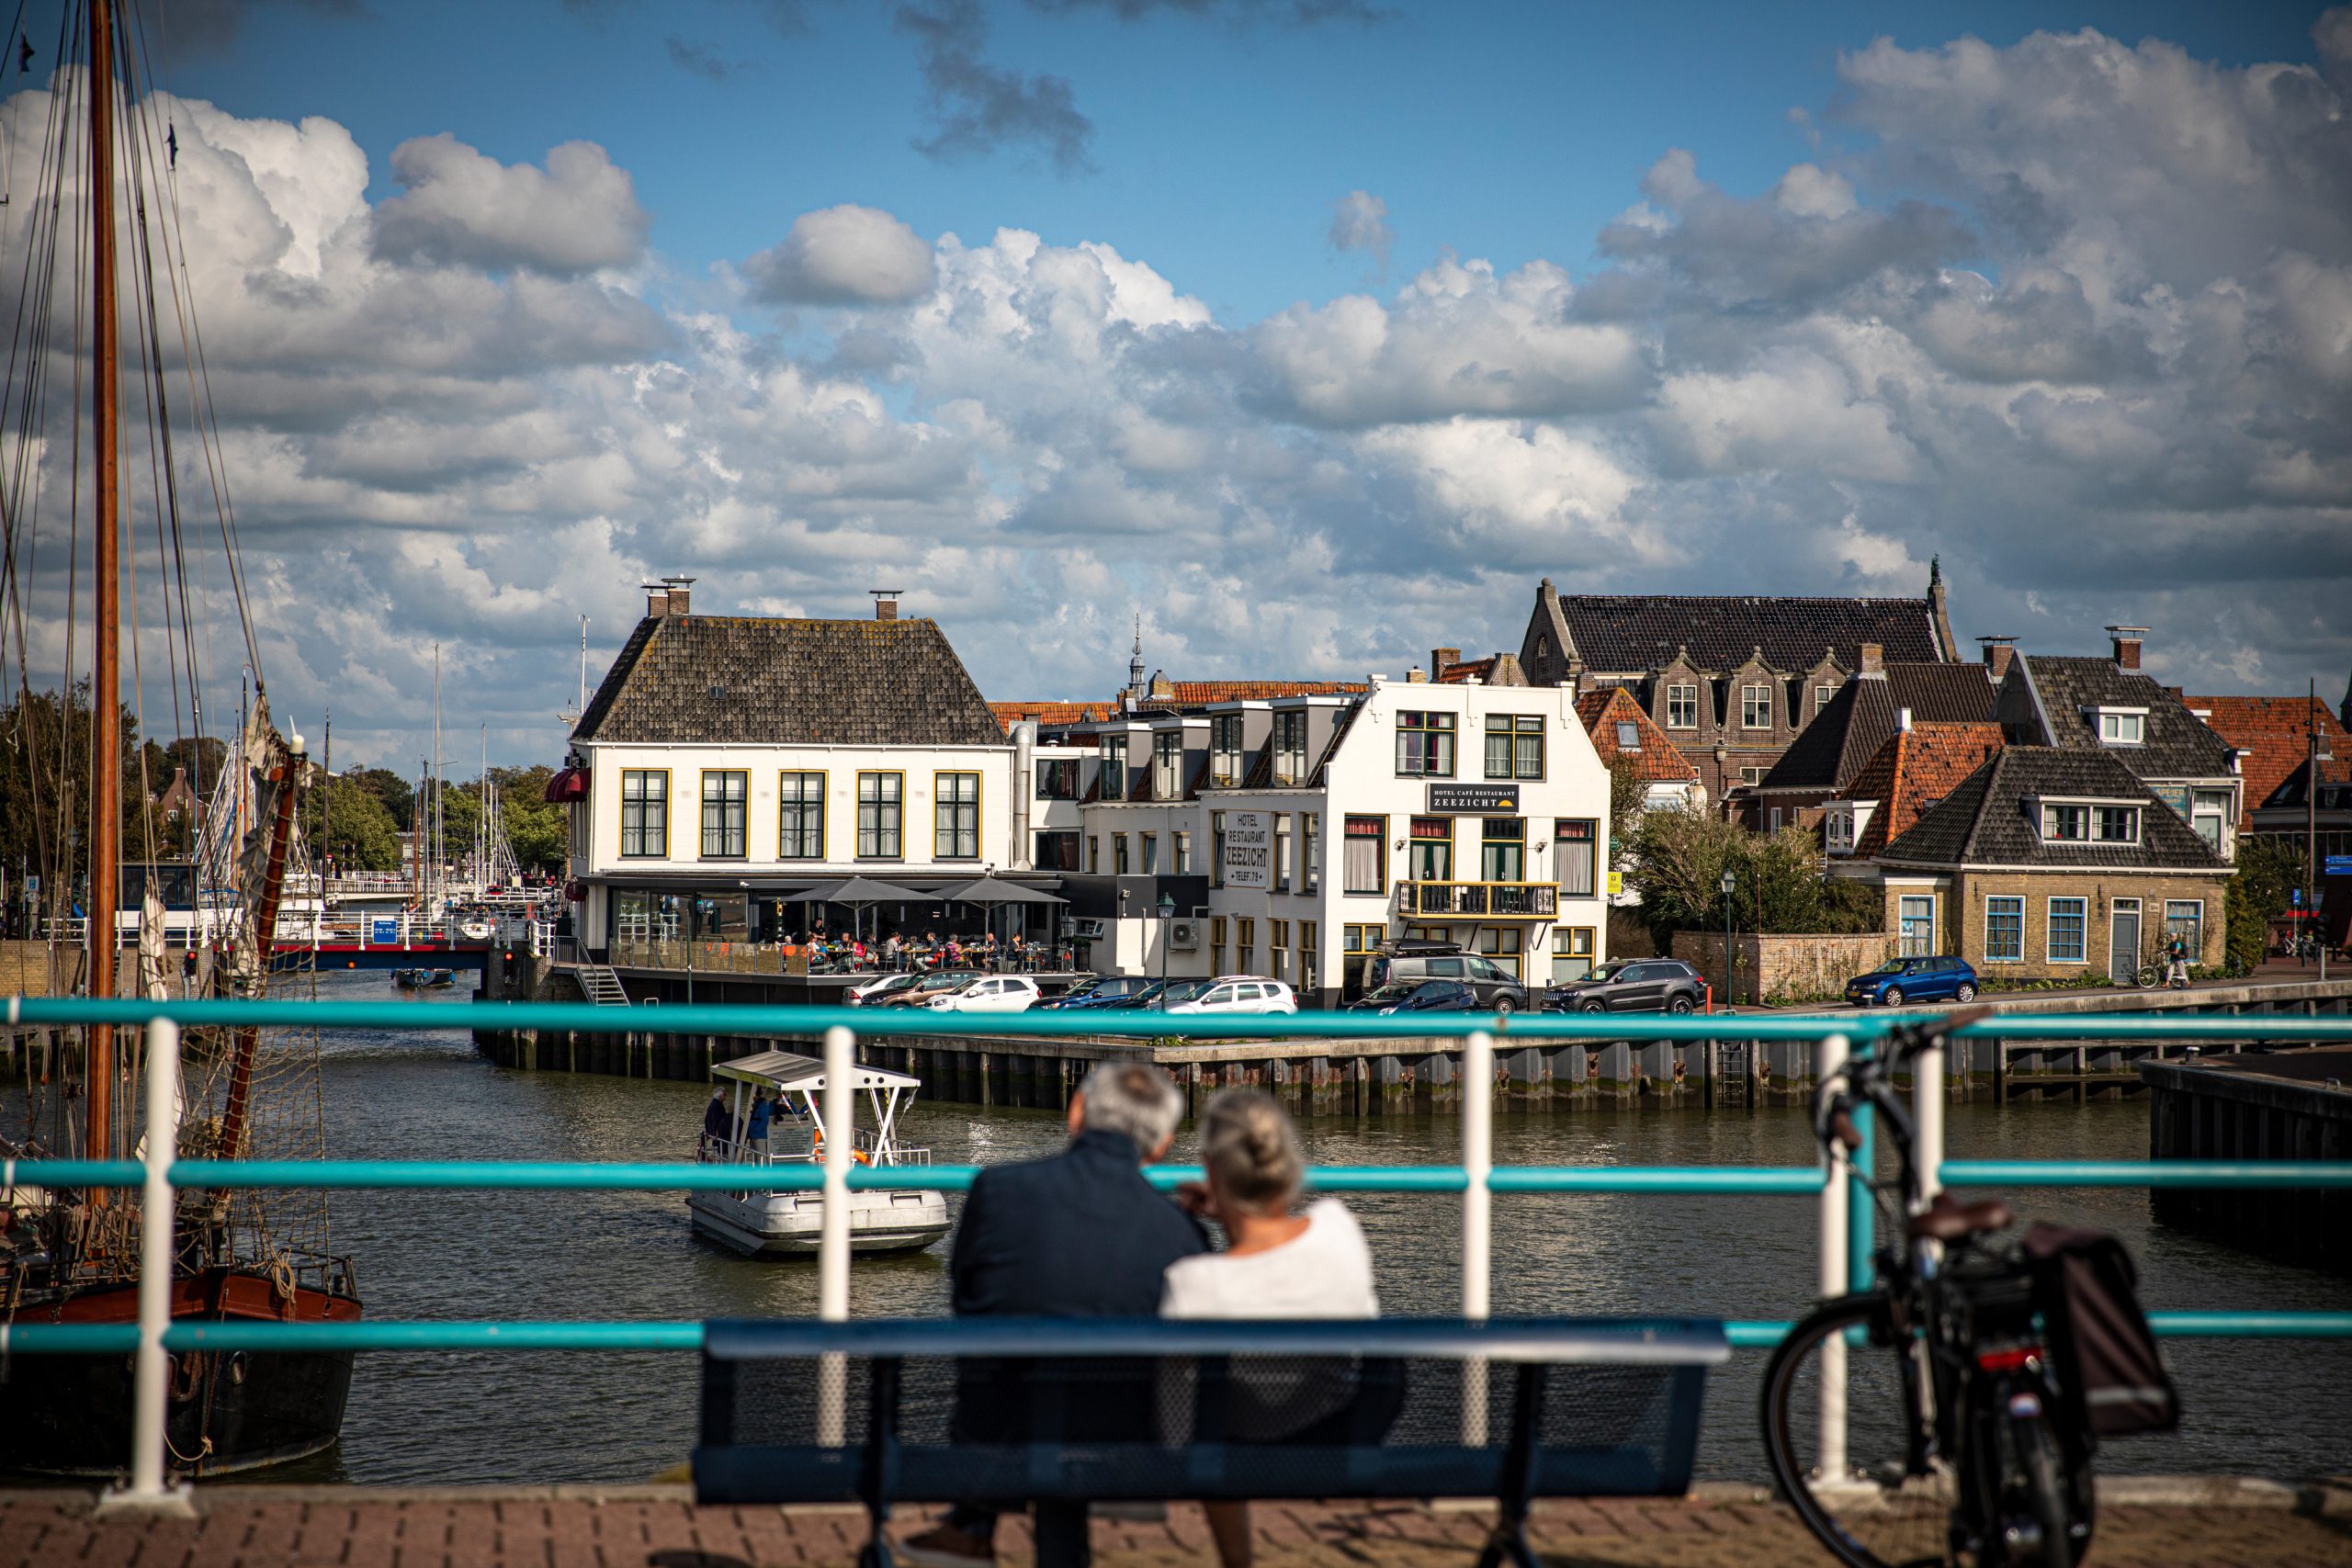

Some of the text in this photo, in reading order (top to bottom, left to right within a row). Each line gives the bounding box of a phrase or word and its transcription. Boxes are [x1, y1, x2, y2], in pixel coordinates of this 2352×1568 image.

[1434, 798, 1497, 807] ZEEZICHT
[1238, 814, 1258, 827] HOTEL
[1228, 830, 1265, 843] RESTAURANT
[1226, 846, 1268, 867] ZEEZICHT
